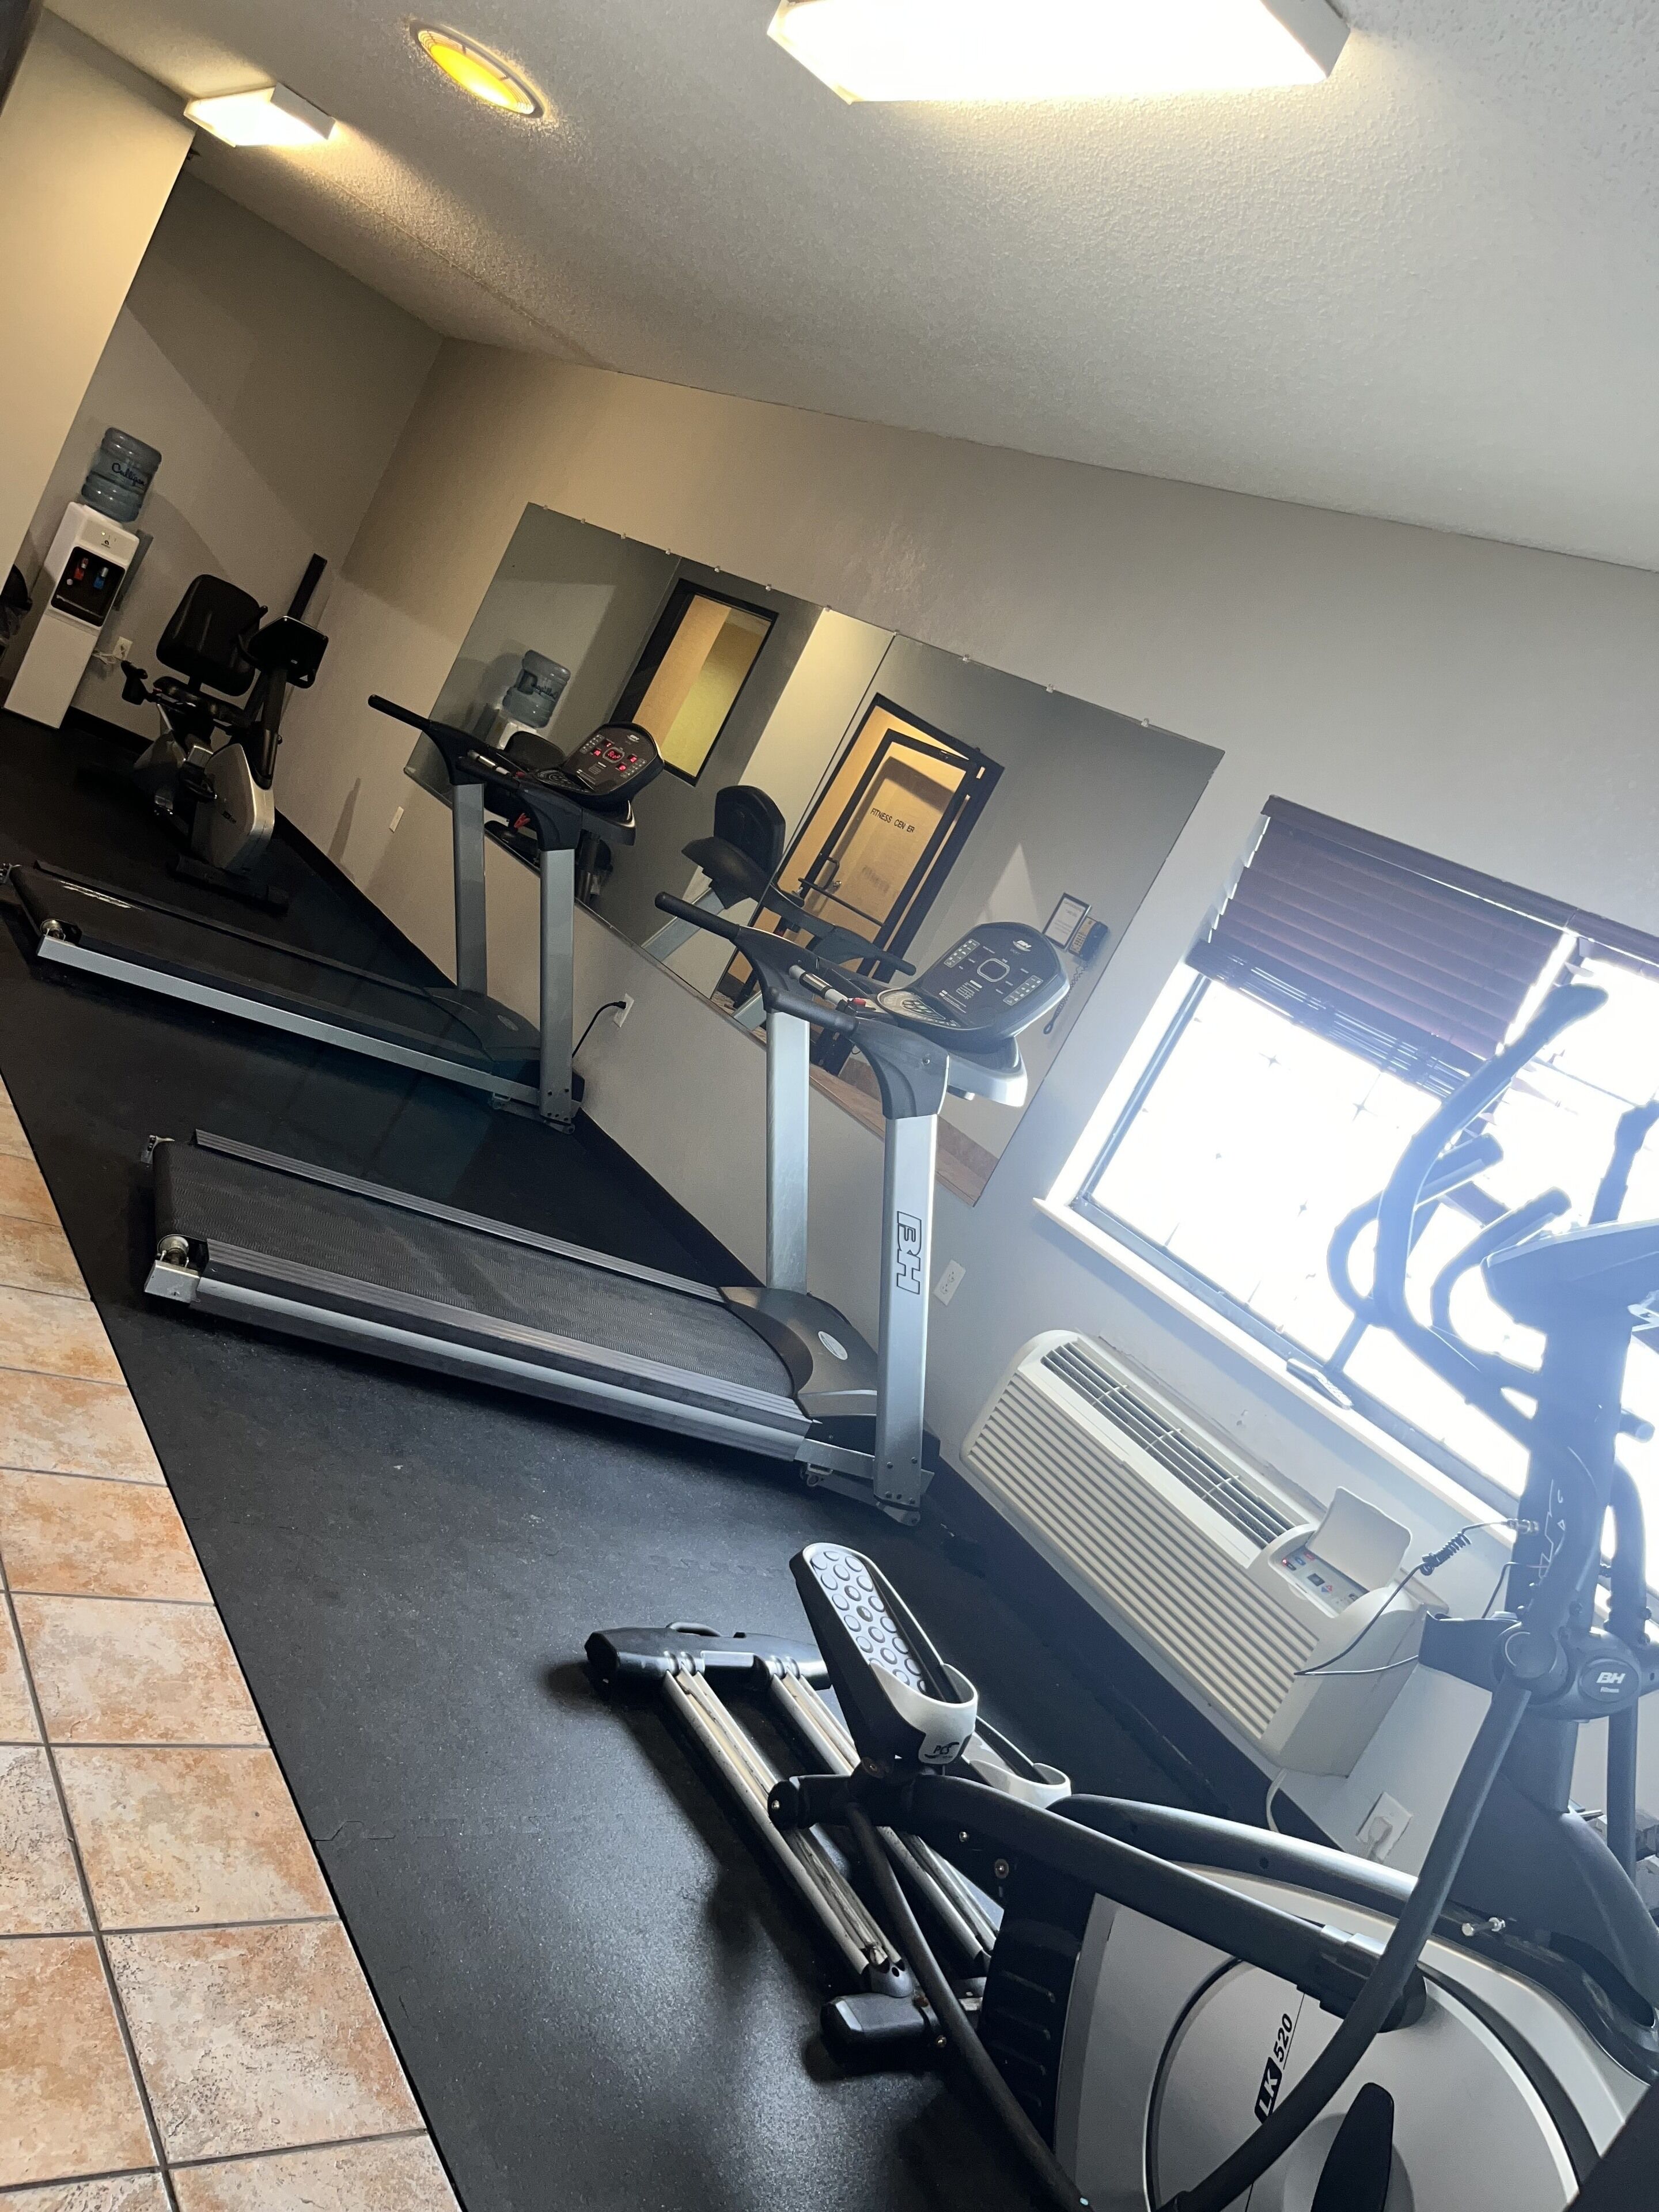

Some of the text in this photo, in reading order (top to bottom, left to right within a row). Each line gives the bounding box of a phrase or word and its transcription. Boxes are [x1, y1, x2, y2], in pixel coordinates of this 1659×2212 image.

[112, 463, 145, 487] Culligan
[870, 808, 893, 824] FITNESS
[897, 1211, 922, 1295] BH
[1596, 1672, 1626, 1684] BH
[1258, 2013, 1293, 2118] LK 520
